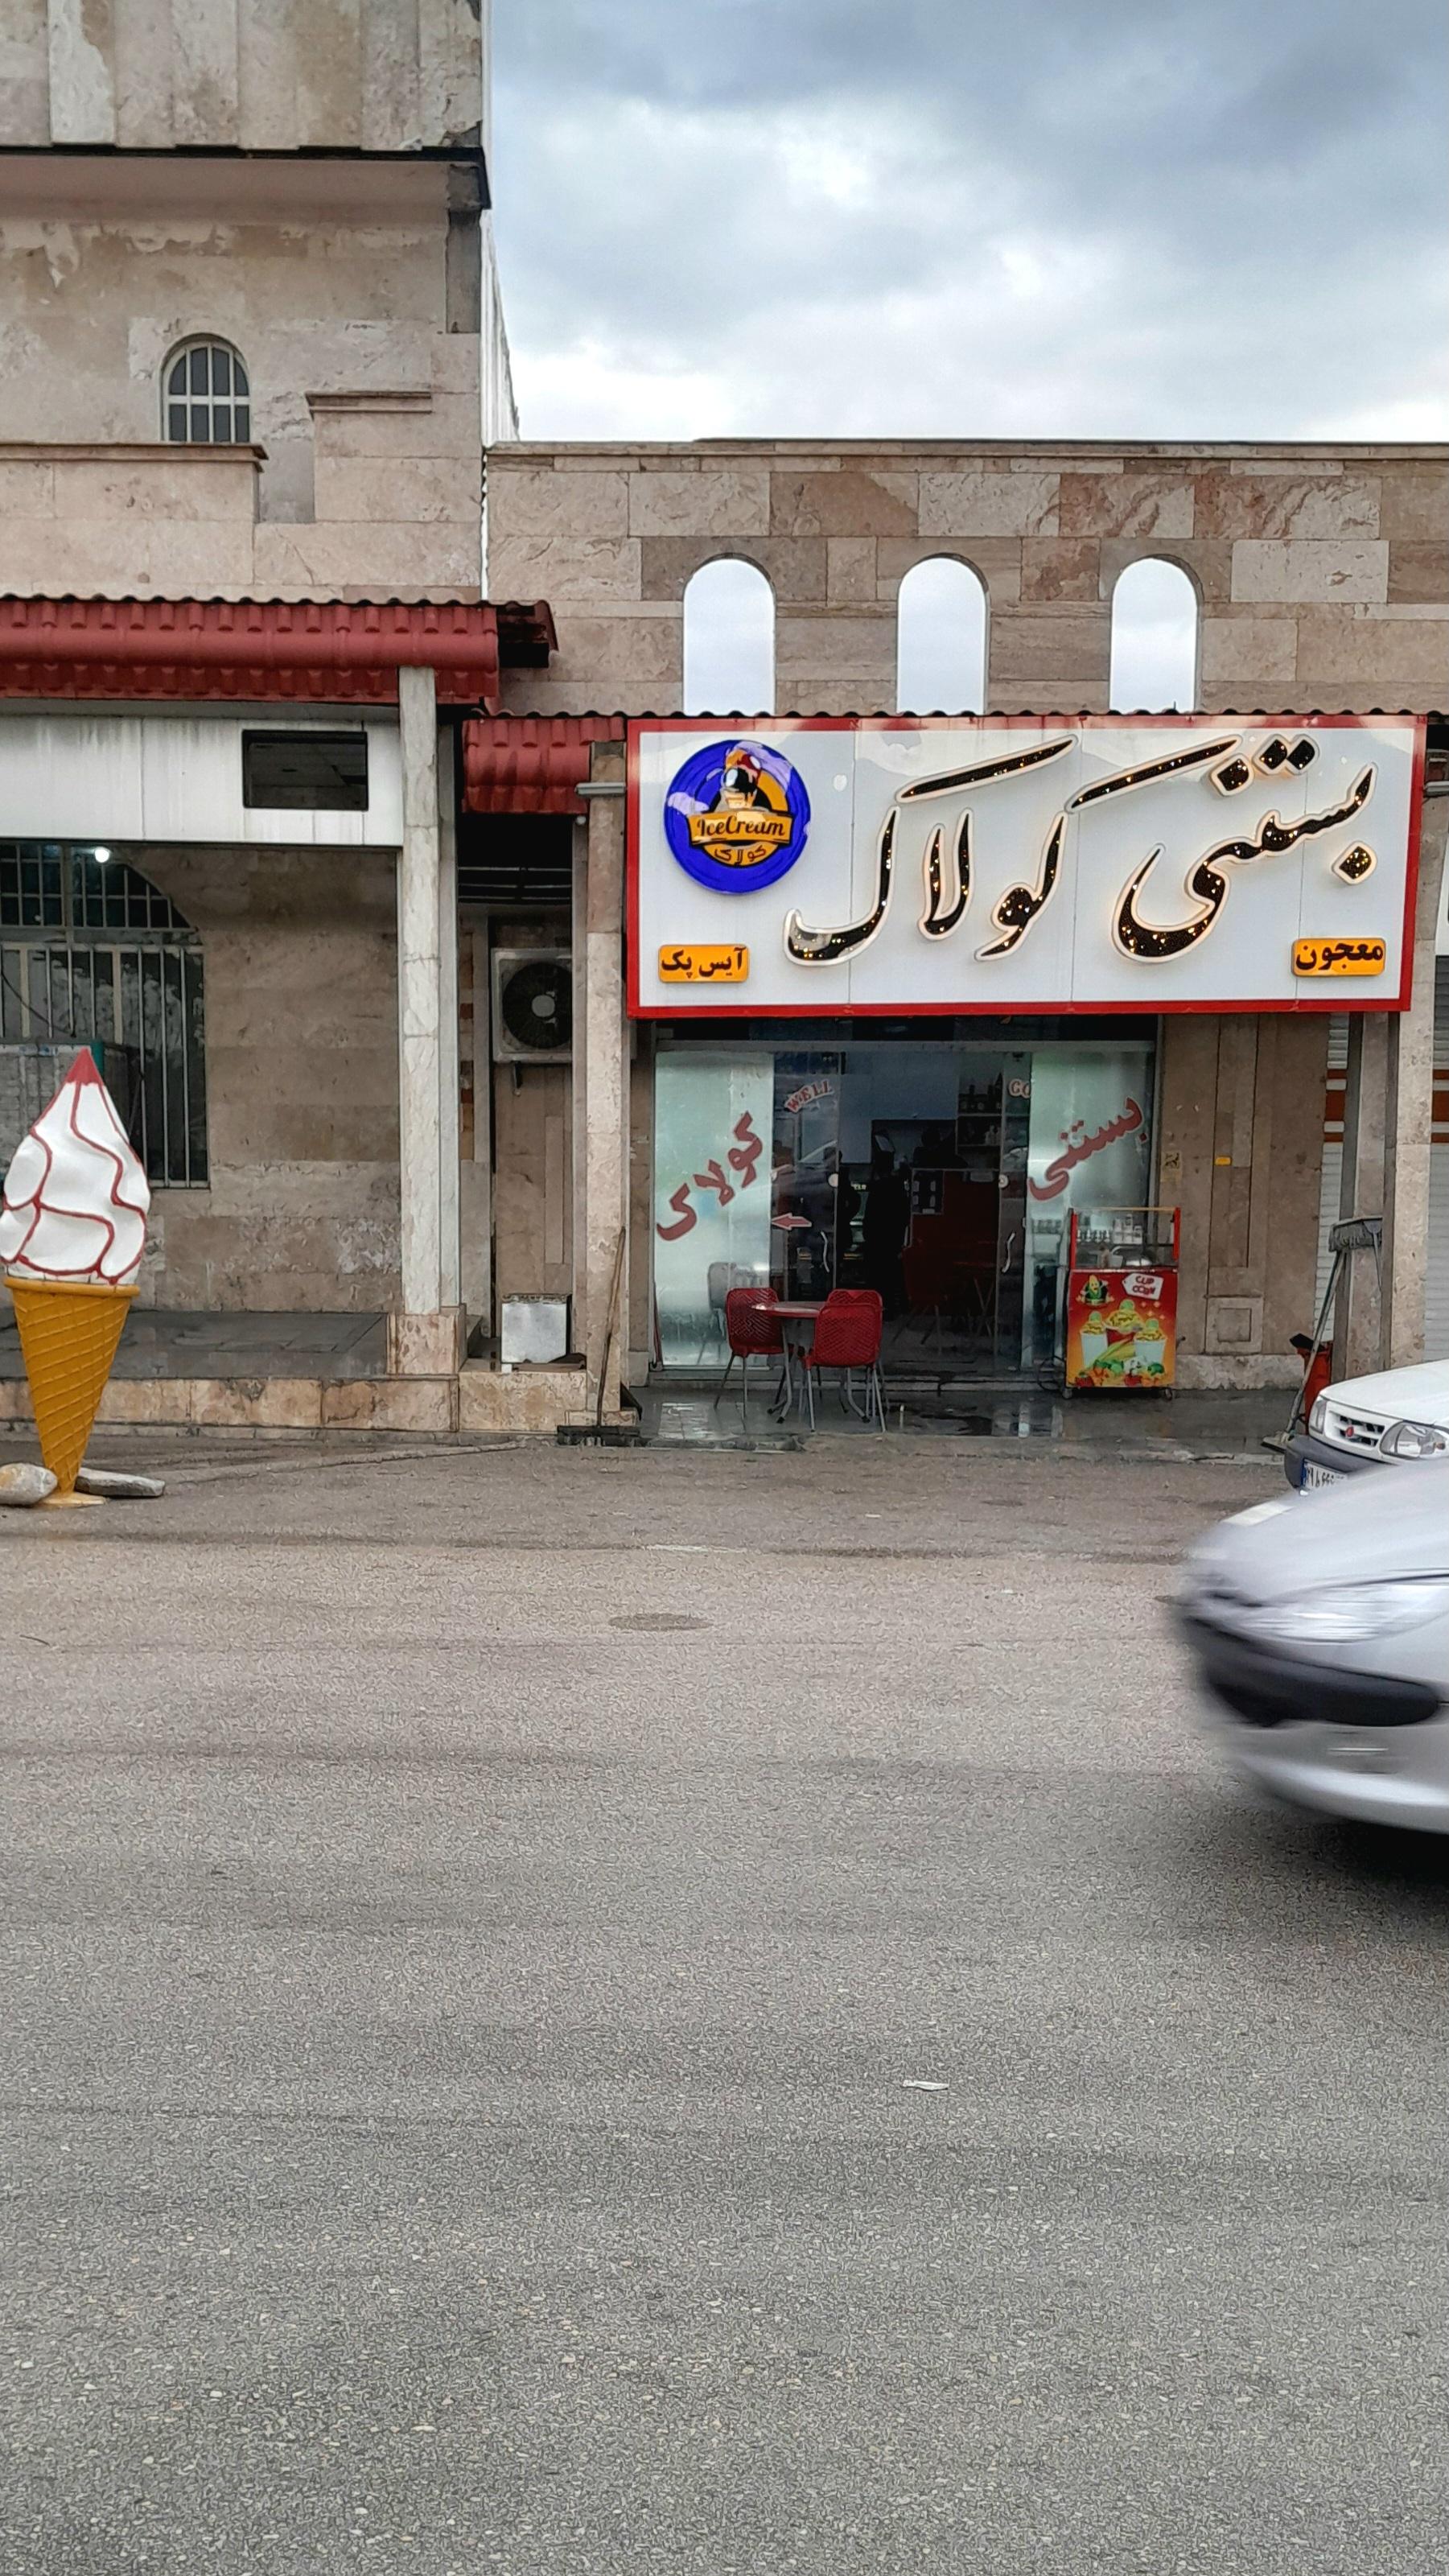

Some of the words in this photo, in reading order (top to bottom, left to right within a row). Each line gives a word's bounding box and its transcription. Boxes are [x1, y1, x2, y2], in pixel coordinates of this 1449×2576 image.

[696, 815, 786, 837] IceCream
[714, 845, 767, 867] کولاک
[785, 736, 1240, 965] کولاک
[1114, 736, 1377, 961] بستنی
[661, 949, 694, 979] پک
[698, 946, 747, 978] آیس
[1295, 942, 1384, 971] معجون
[785, 1079, 834, 1112] WELL
[1027, 1096, 1148, 1201] بستنی
[656, 1110, 764, 1242] کولاک
[1135, 1275, 1155, 1285] CUP
